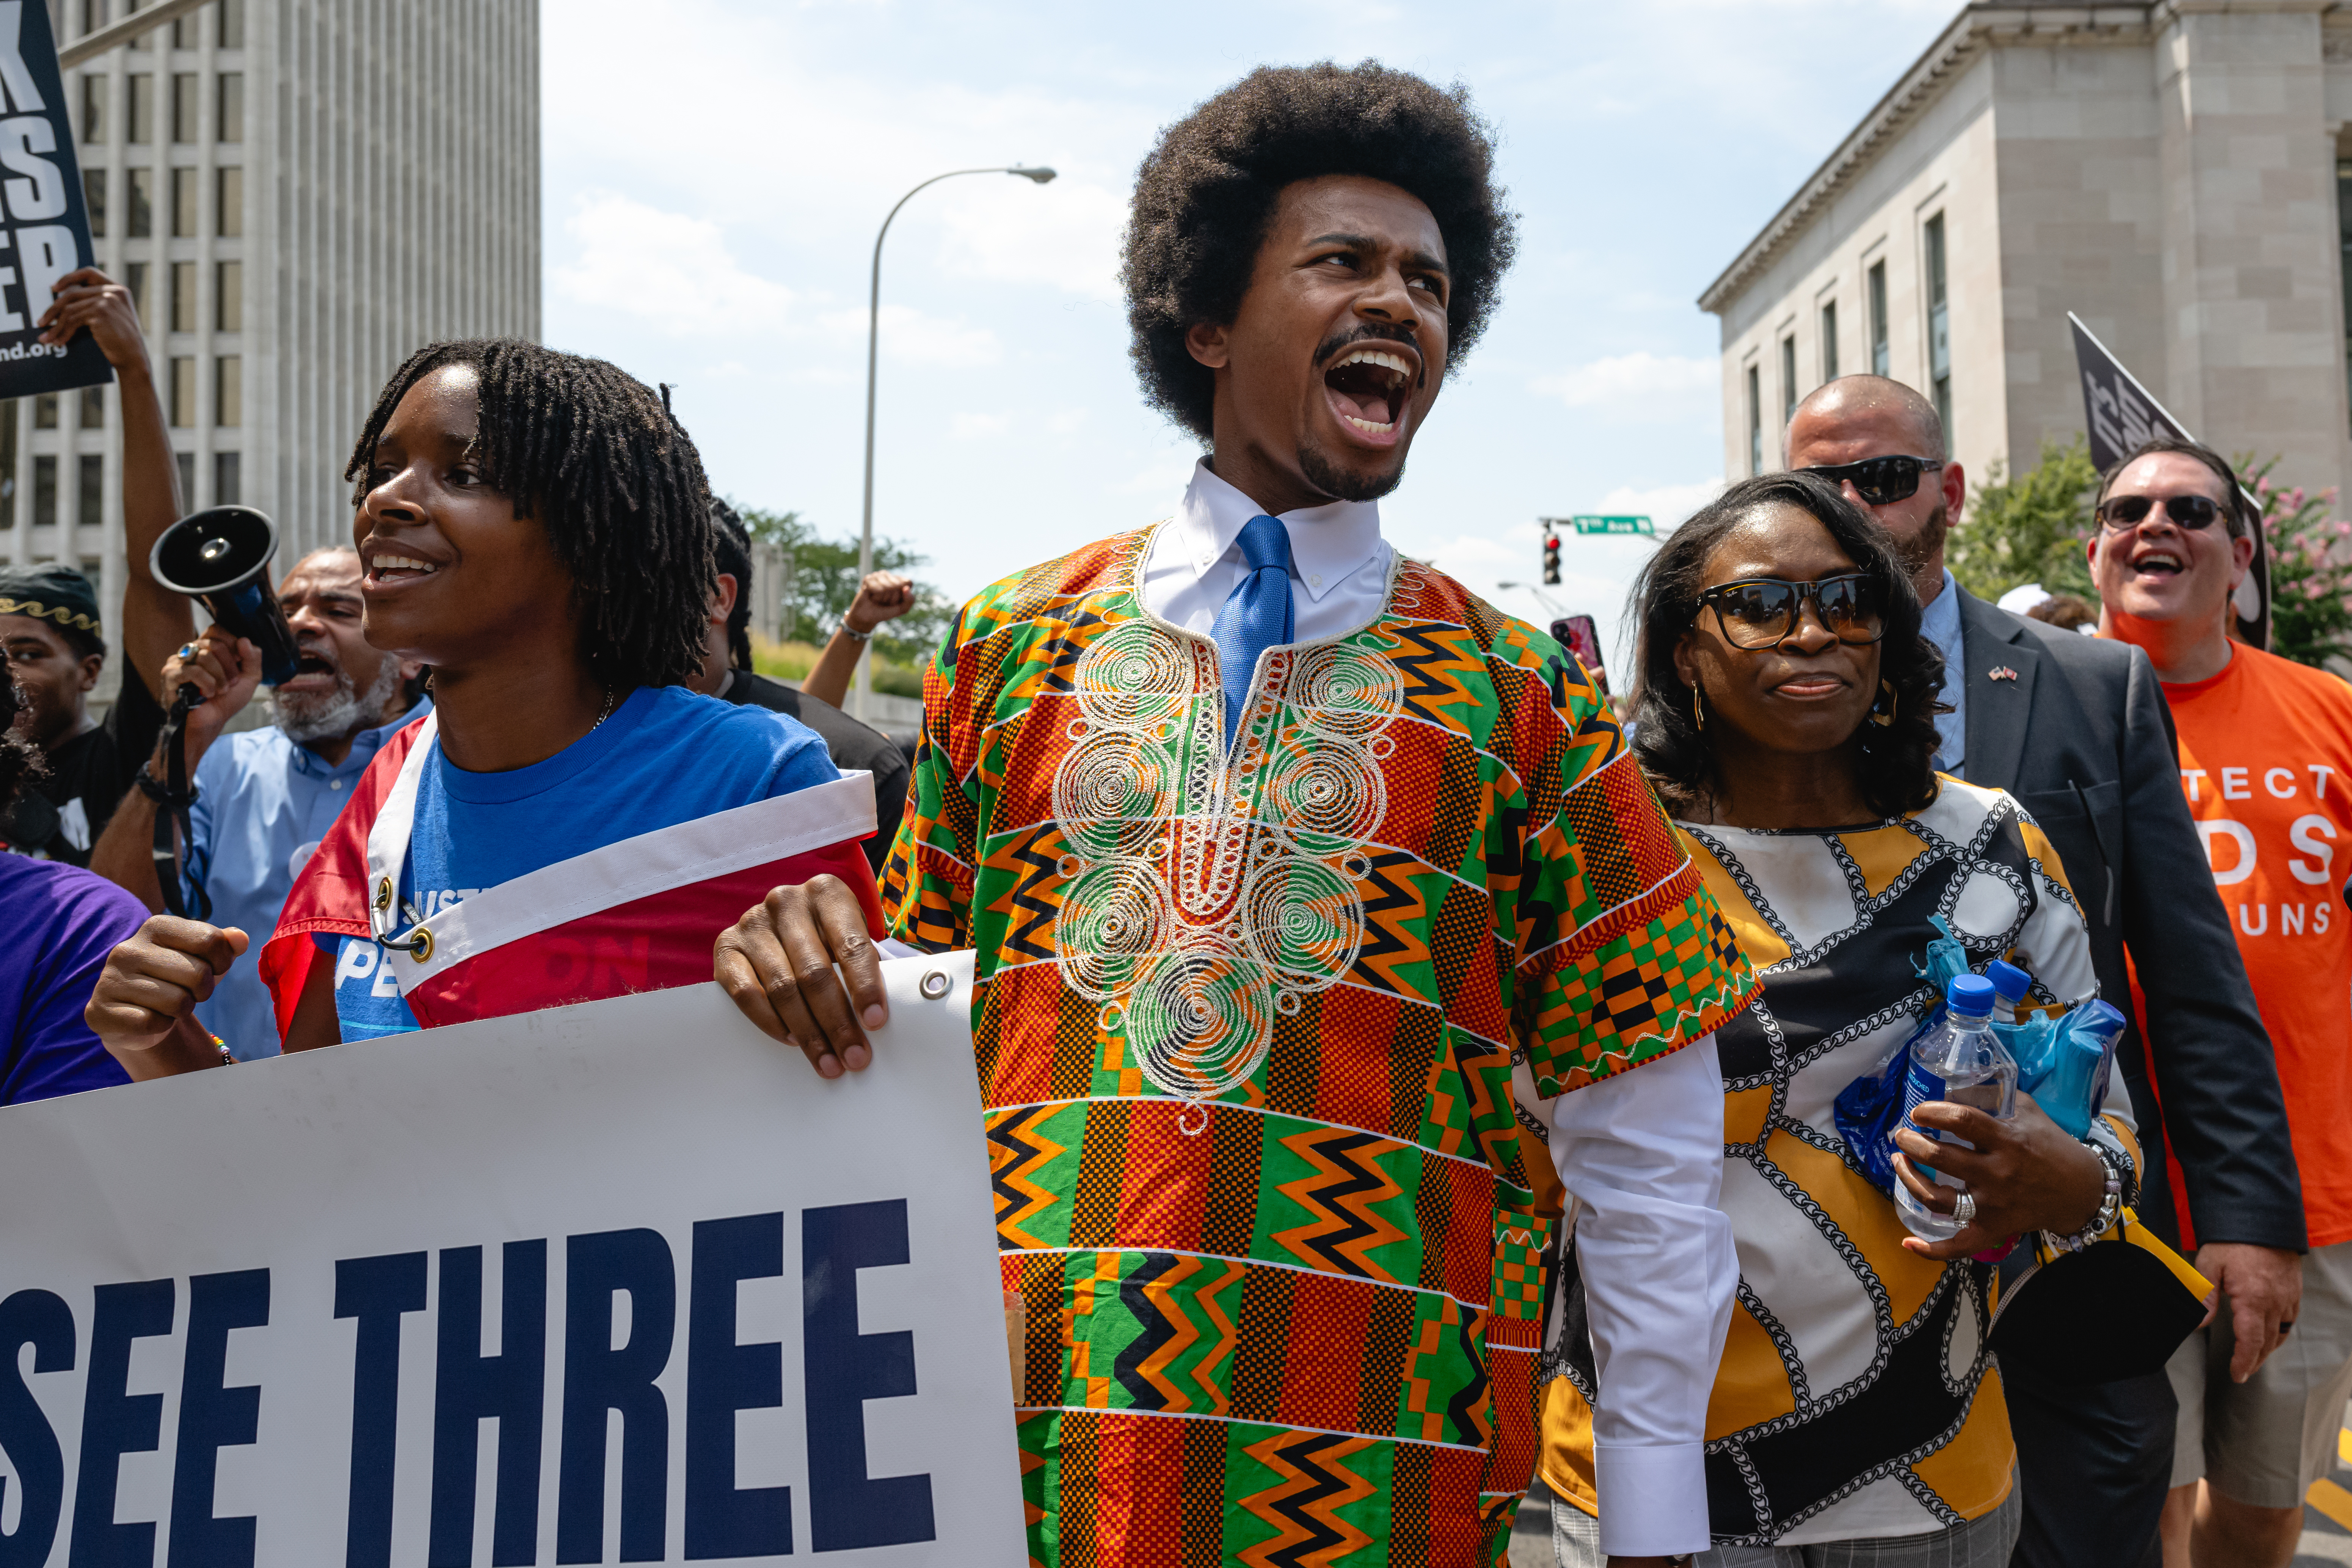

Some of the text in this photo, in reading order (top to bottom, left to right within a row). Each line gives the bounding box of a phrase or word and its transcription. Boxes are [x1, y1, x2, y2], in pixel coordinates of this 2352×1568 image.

[0, 116, 67, 223] S
[2181, 764, 2335, 801] TECT
[409, 910, 421, 923] AXON
[2239, 902, 2331, 936] UNS
[0, 1198, 936, 1568] SEE THREE
